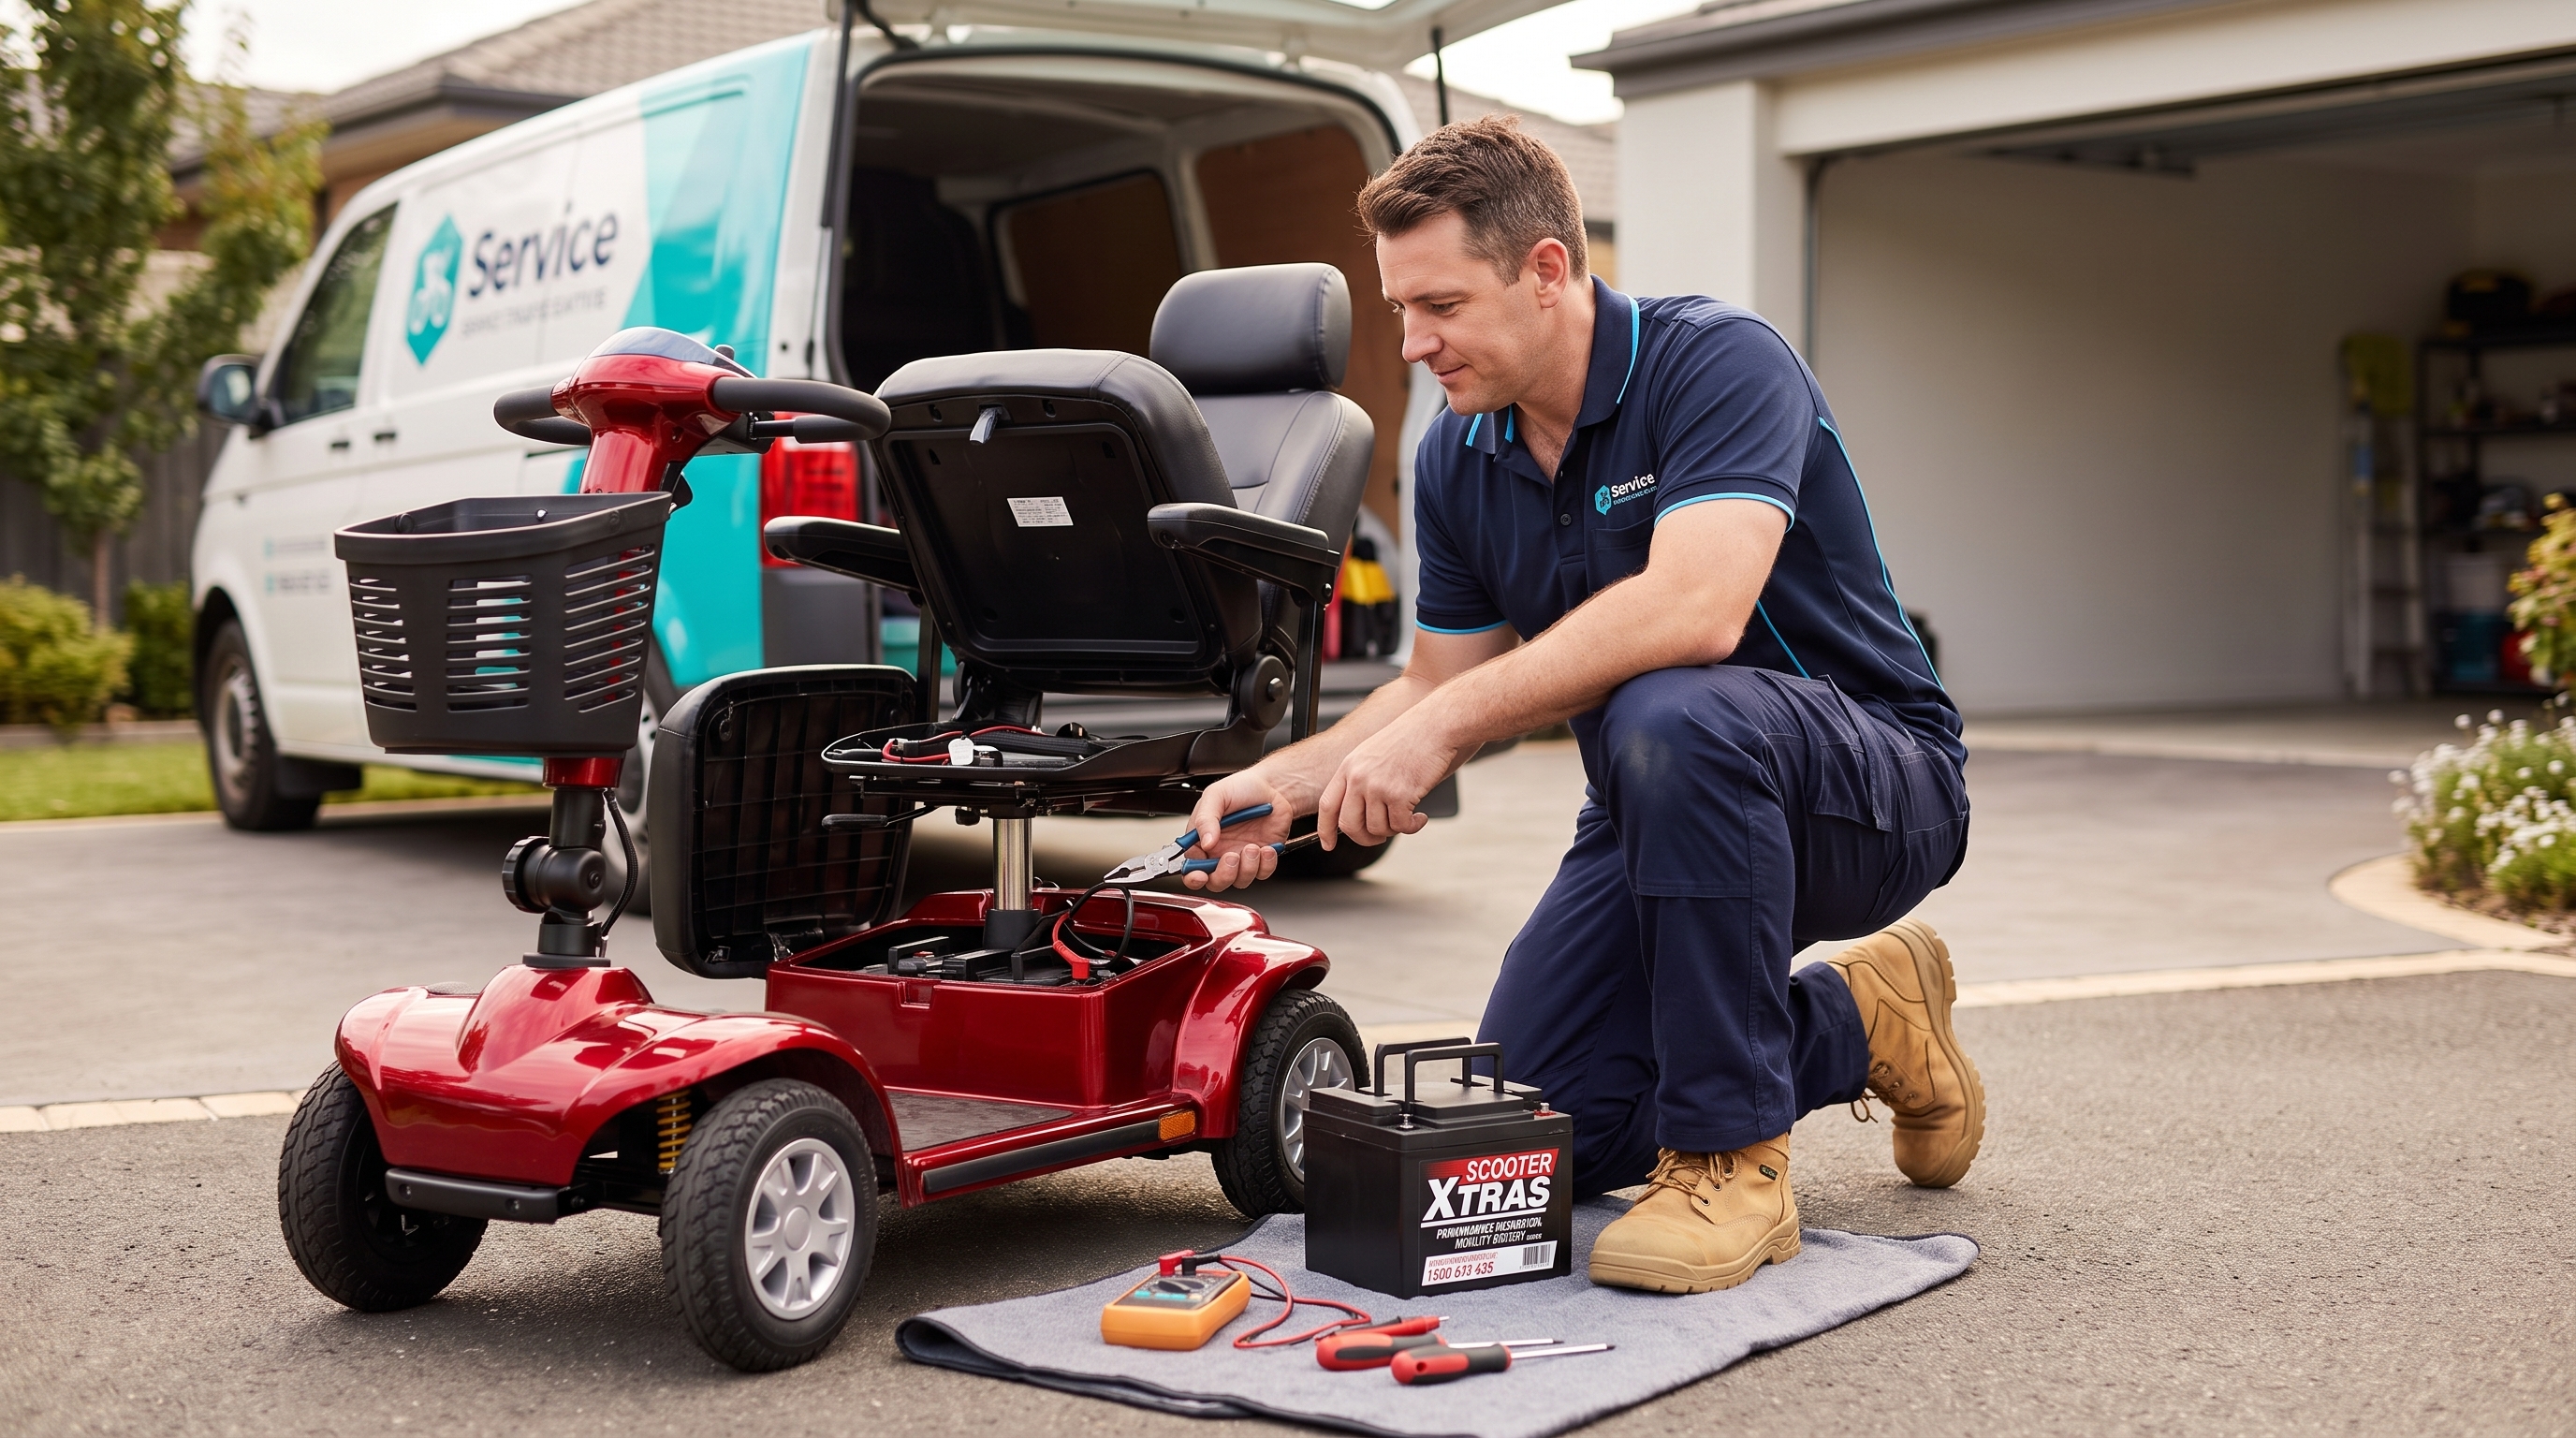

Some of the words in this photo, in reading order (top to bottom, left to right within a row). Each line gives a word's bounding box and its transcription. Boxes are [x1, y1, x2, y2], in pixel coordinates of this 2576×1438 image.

[469, 198, 619, 298] Service
[1611, 474, 1656, 498] Service
[1466, 1152, 1552, 1182] SCOOTER
[1422, 1176, 1551, 1222] XTRAS
